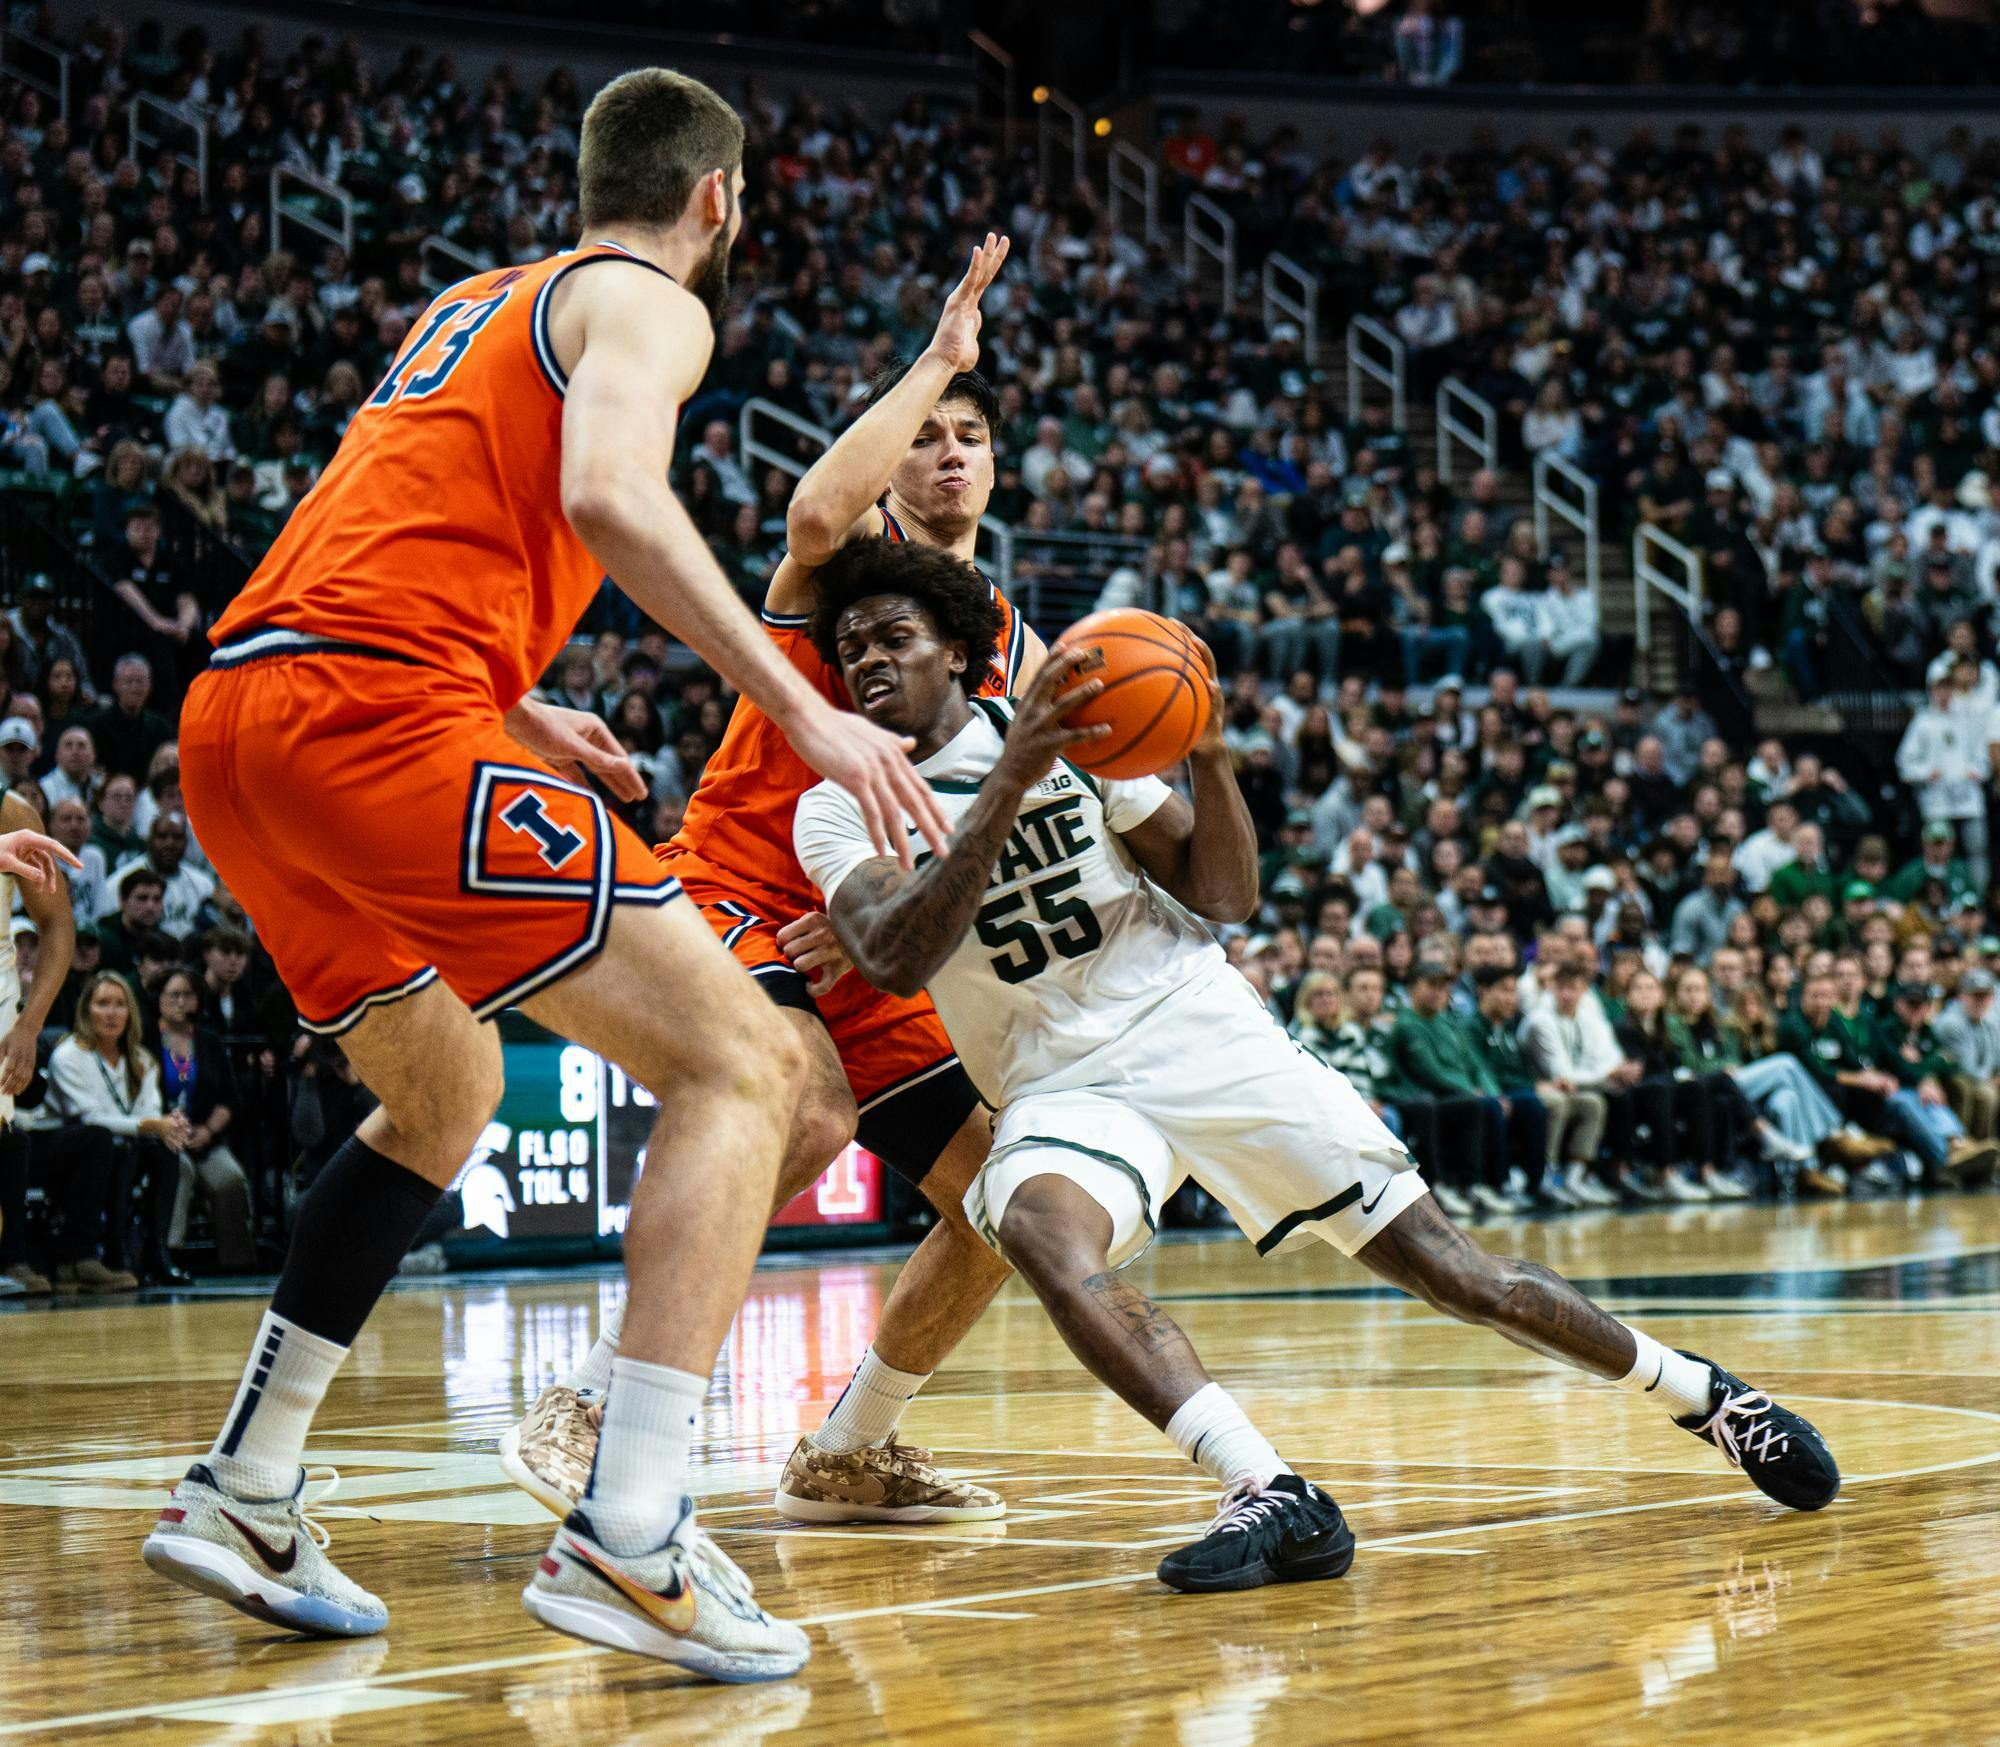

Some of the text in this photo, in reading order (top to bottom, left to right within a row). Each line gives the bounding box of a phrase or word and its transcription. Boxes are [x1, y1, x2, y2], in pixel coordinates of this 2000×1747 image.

[364, 286, 514, 409] 13
[498, 788, 587, 872] I
[974, 867, 1104, 985] 55
[560, 1045, 597, 1123] 8
